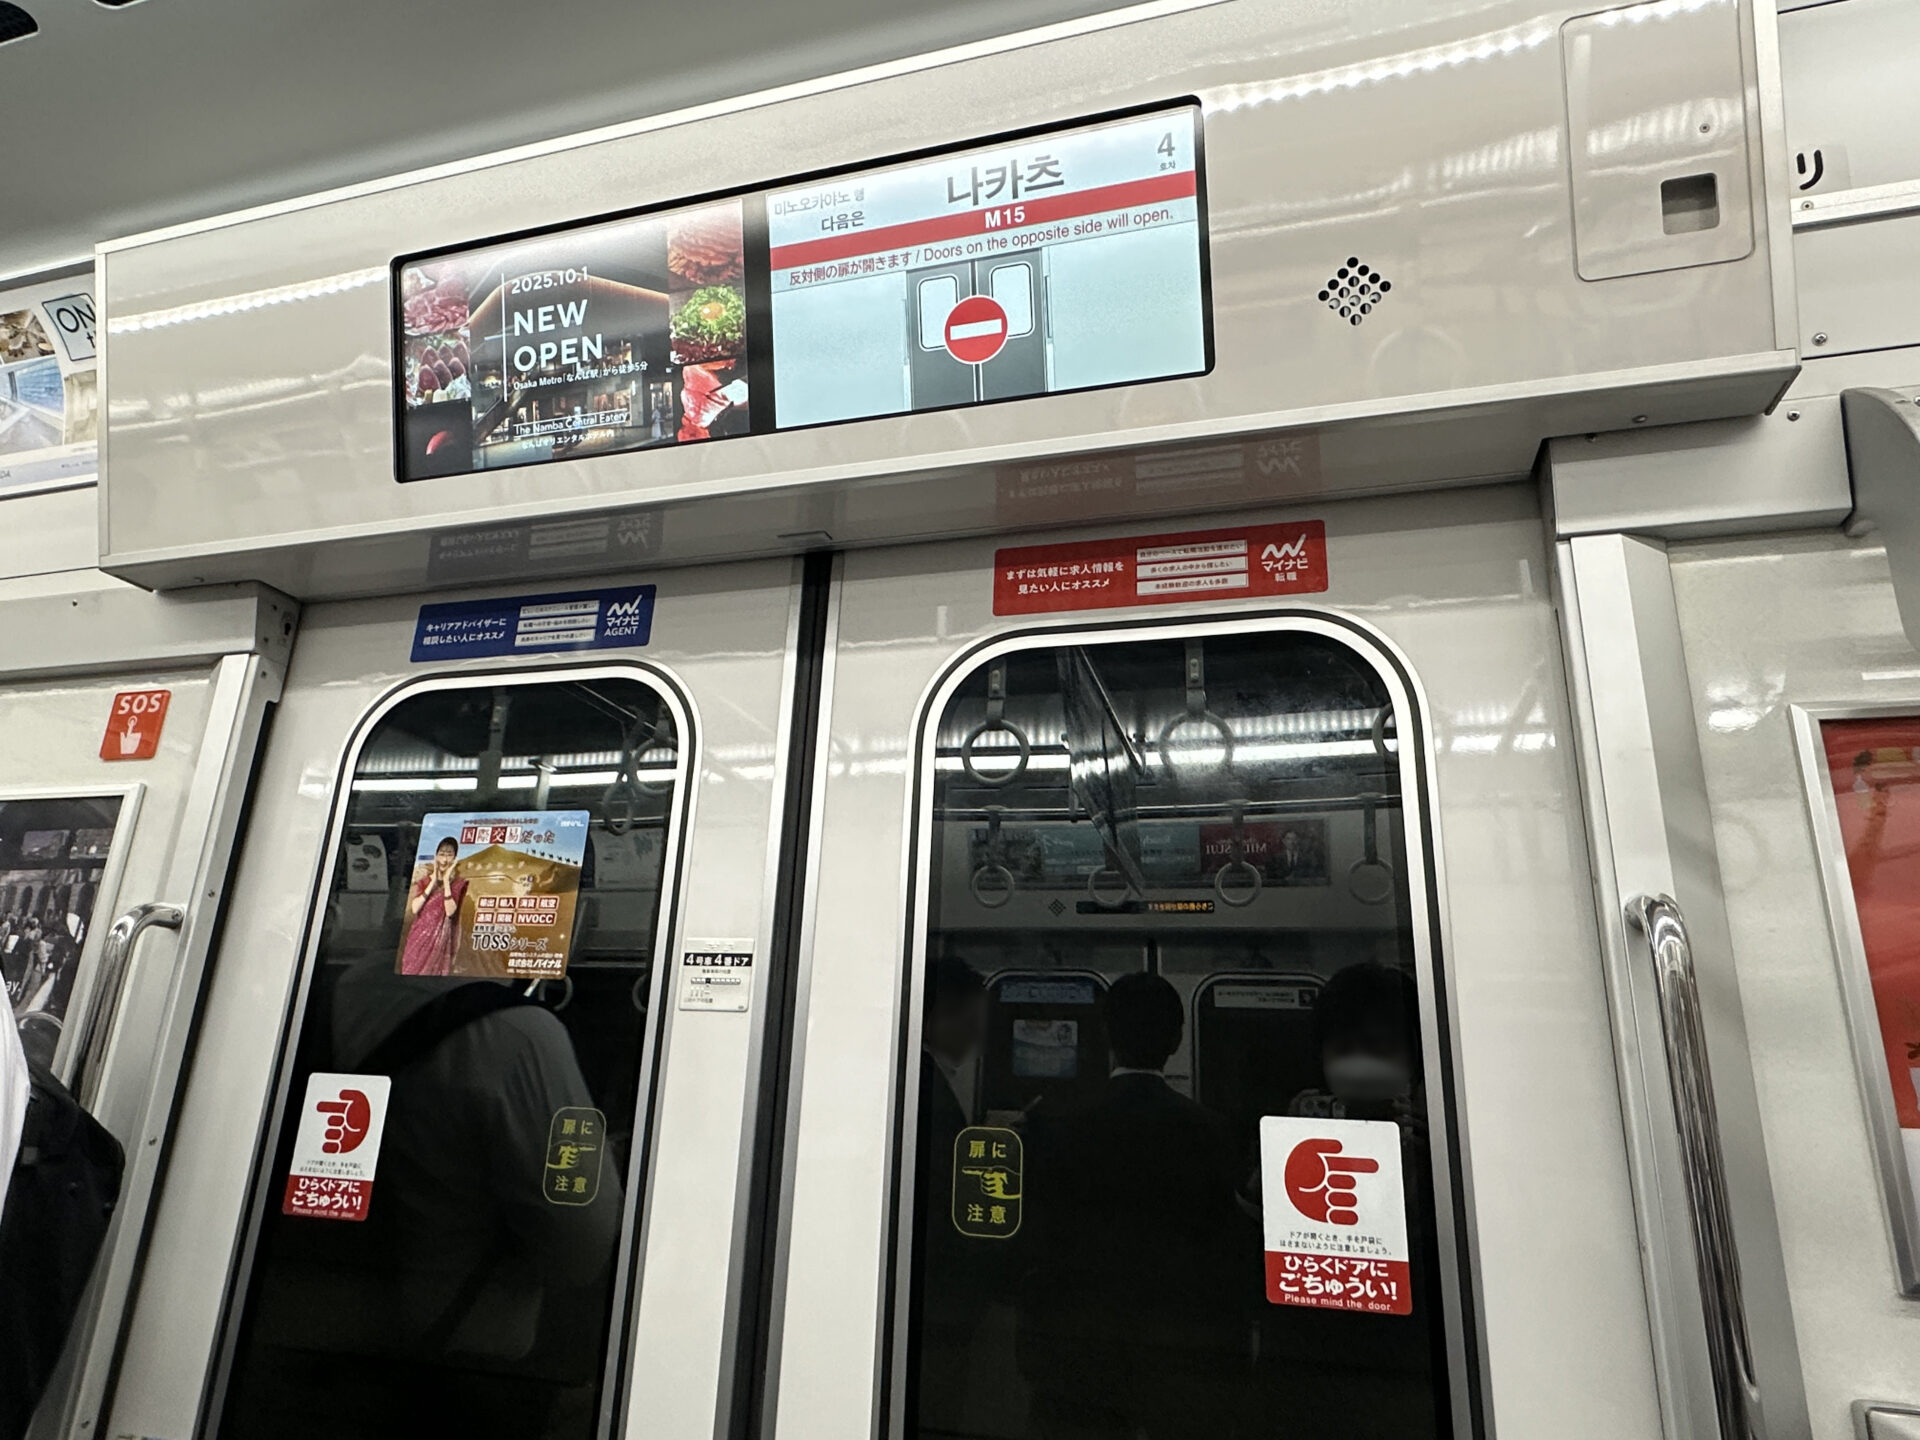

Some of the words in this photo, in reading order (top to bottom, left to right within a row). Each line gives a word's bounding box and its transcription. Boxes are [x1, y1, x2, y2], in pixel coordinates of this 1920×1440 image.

[1157, 132, 1176, 158] 4
[946, 154, 1065, 207] 나카츠
[774, 191, 851, 216] 미노오카야노
[821, 210, 865, 232] 다음은
[984, 206, 1026, 229] M15
[789, 251, 912, 286] 反対側の扉が開きます
[923, 243, 963, 262] Doors
[966, 239, 983, 254] on
[987, 234, 1008, 251] the
[1012, 222, 1070, 248] opposite
[1073, 218, 1103, 236] side
[1107, 212, 1129, 230] will
[1133, 207, 1174, 228] open.
[511, 266, 588, 294] 2025.10.1
[513, 299, 588, 336] NEW
[513, 333, 603, 372] OPEN
[513, 380, 538, 391] Osaka
[539, 376, 563, 387] Metro
[515, 424, 531, 435] The
[533, 421, 564, 434] Namba
[565, 416, 597, 429] Central
[600, 411, 628, 424] Eatery
[1006, 560, 1125, 581] まずは気軽に求人情報を
[1261, 558, 1309, 573] マイナビ
[1017, 577, 1111, 595] 見たい人にオススメ
[1274, 571, 1298, 583] 転職
[425, 618, 507, 633] キャリアアドバイザーに
[603, 625, 639, 637] AGENT
[606, 615, 640, 627] マイナビ
[422, 630, 505, 646] 相談したい人にオススメ
[117, 693, 162, 715] SOS
[517, 913, 555, 924] NVOCC
[562, 1118, 593, 1135] 扉に
[969, 1140, 1006, 1158] 扉に
[299, 1178, 360, 1193] ひらくドアに
[555, 1175, 587, 1193] 注意
[291, 1190, 362, 1210] ごちゅうい!
[967, 1203, 1006, 1224] 注意
[1283, 1255, 1389, 1277] ひらくドアに
[1279, 1272, 1397, 1300] ごちゅうい!
[1284, 1293, 1317, 1304] Please
[1320, 1296, 1343, 1307] mind
[1346, 1299, 1362, 1308] the
